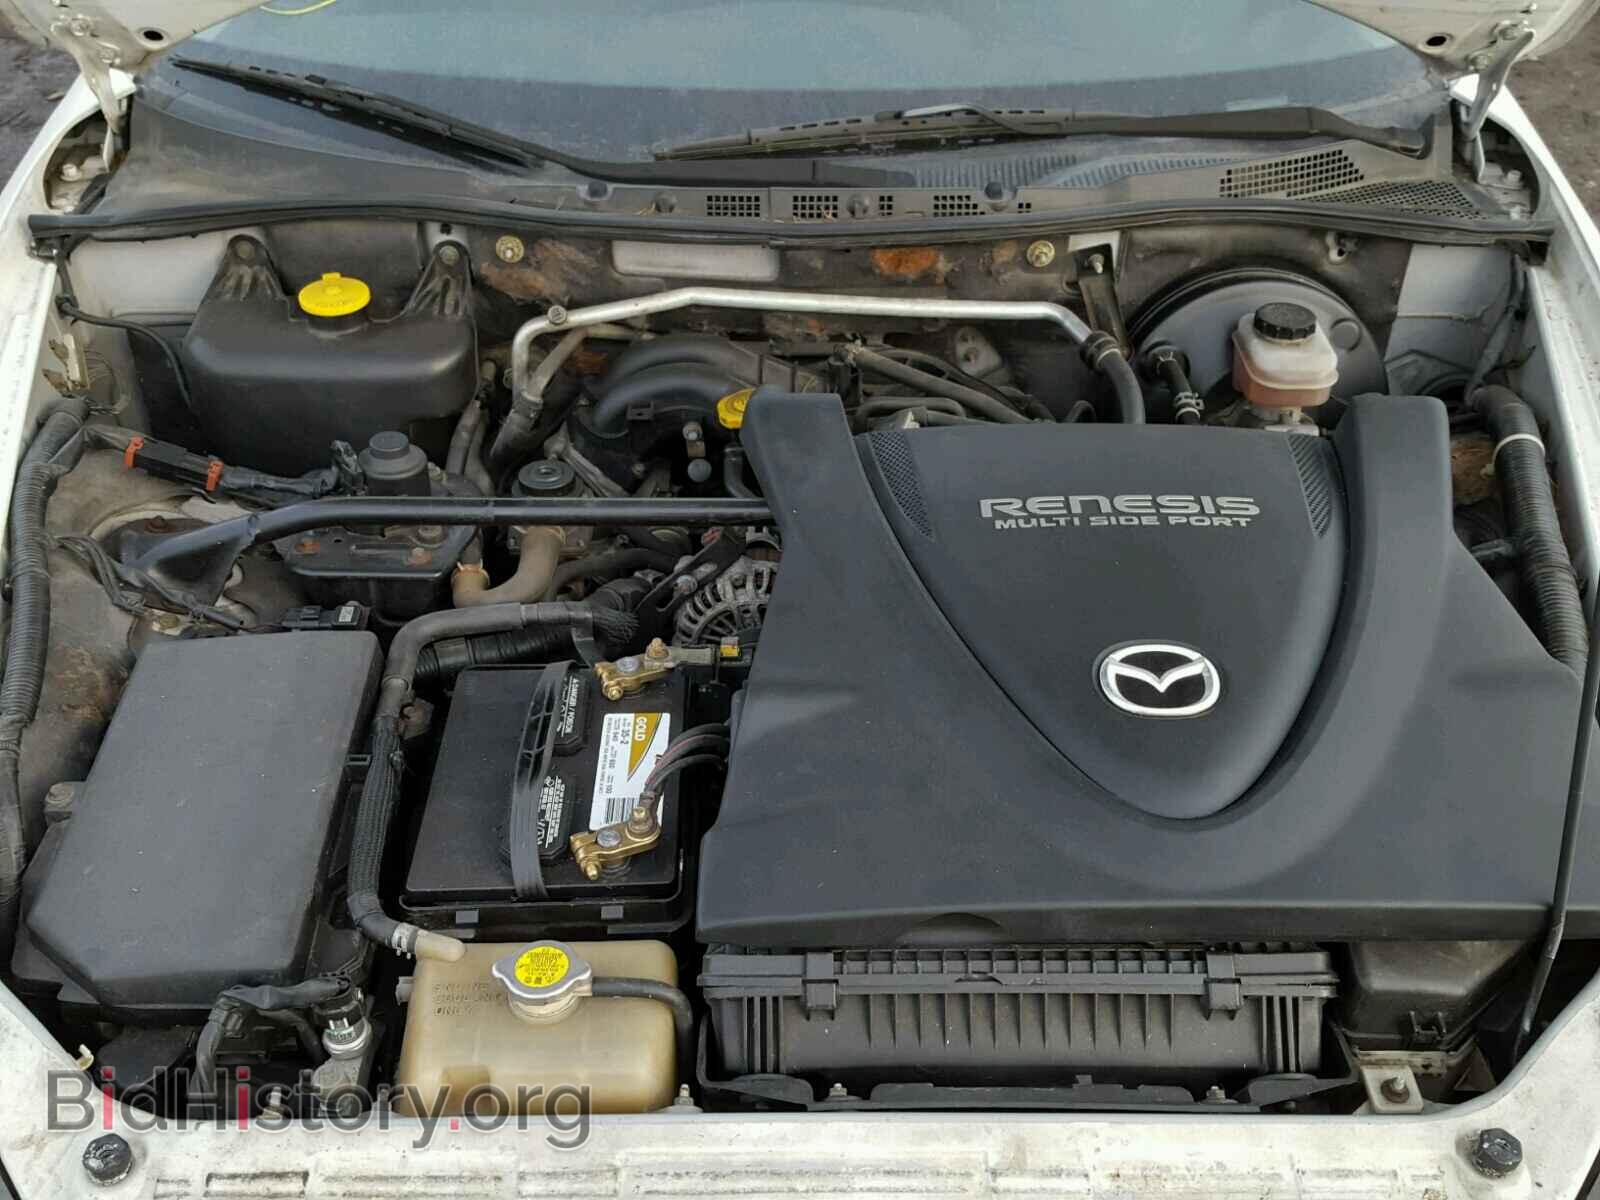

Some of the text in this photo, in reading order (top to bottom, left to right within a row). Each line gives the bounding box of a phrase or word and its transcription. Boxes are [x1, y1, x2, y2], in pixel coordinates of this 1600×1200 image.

[979, 495, 1260, 518] RENESIS
[995, 515, 1251, 529] MULTI SIDE PORT
[635, 716, 648, 741] GOLD
